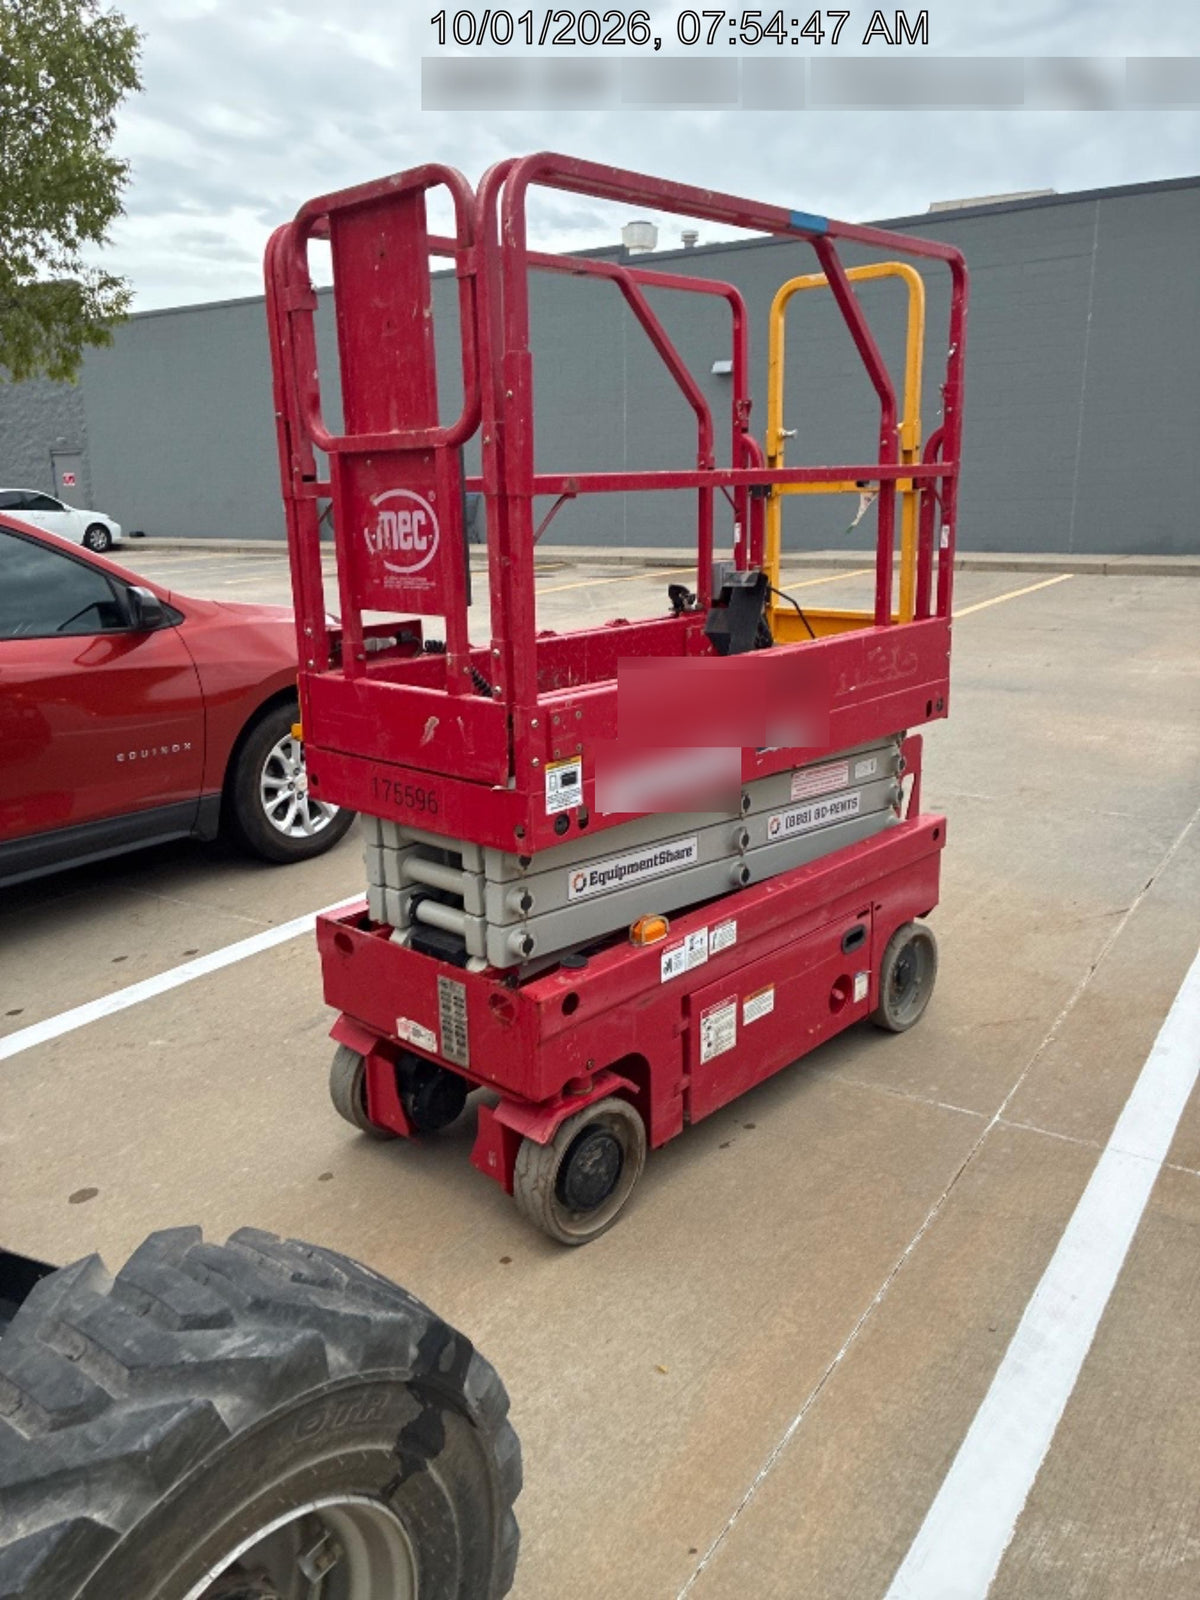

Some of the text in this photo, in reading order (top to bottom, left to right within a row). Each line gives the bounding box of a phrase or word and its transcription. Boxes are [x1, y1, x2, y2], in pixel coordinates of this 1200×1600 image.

[116, 742, 192, 762] EQUINOX
[372, 776, 438, 815] 175596
[589, 846, 693, 886] EquipmentShare
